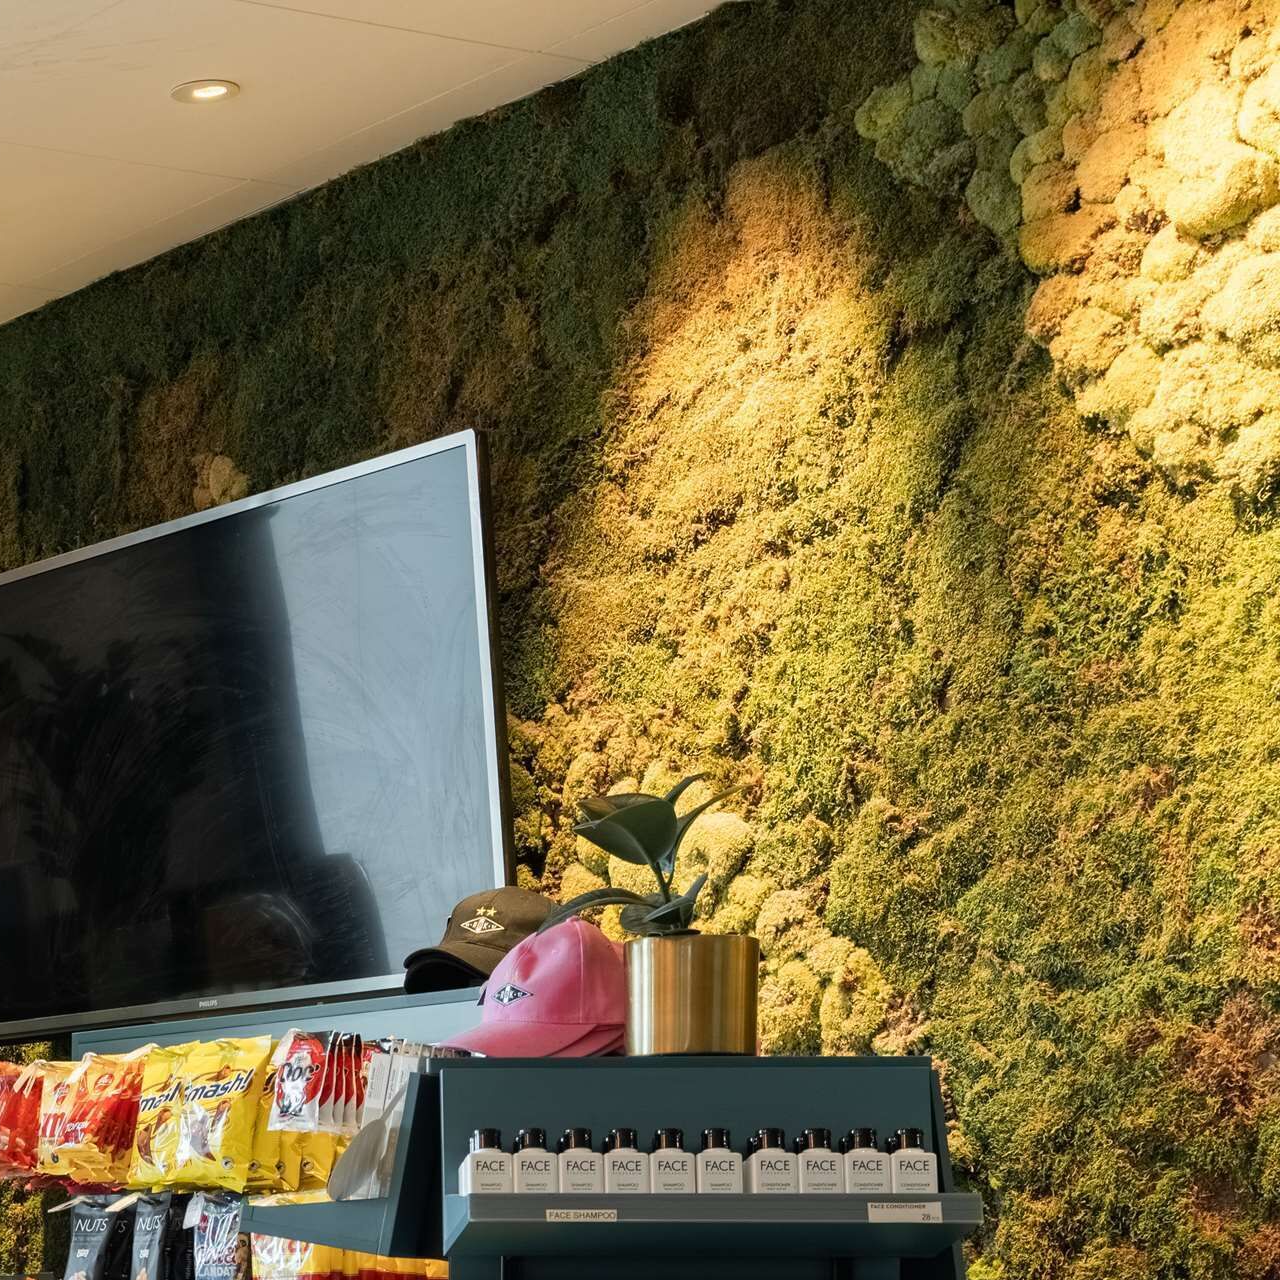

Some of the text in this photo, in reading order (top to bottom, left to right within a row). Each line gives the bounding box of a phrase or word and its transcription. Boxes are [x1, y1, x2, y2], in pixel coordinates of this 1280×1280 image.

[199, 1000, 218, 1008] PHILIPS
[476, 1160, 504, 1171] FACE
[521, 1160, 550, 1171] FACE
[566, 1160, 595, 1171] FACE
[612, 1160, 641, 1171] FACE
[658, 1160, 688, 1171] FACE
[705, 1160, 735, 1171] FACE
[760, 1160, 790, 1171] FACE
[806, 1160, 836, 1171] FACE
[852, 1160, 882, 1171] FACE
[899, 1160, 929, 1171] FACE
[549, 1211, 616, 1219] FACE SHAMPOO
[75, 1218, 109, 1233] NUTS
[136, 1214, 162, 1231] NUTS
[198, 1266, 238, 1277] LANDAT
